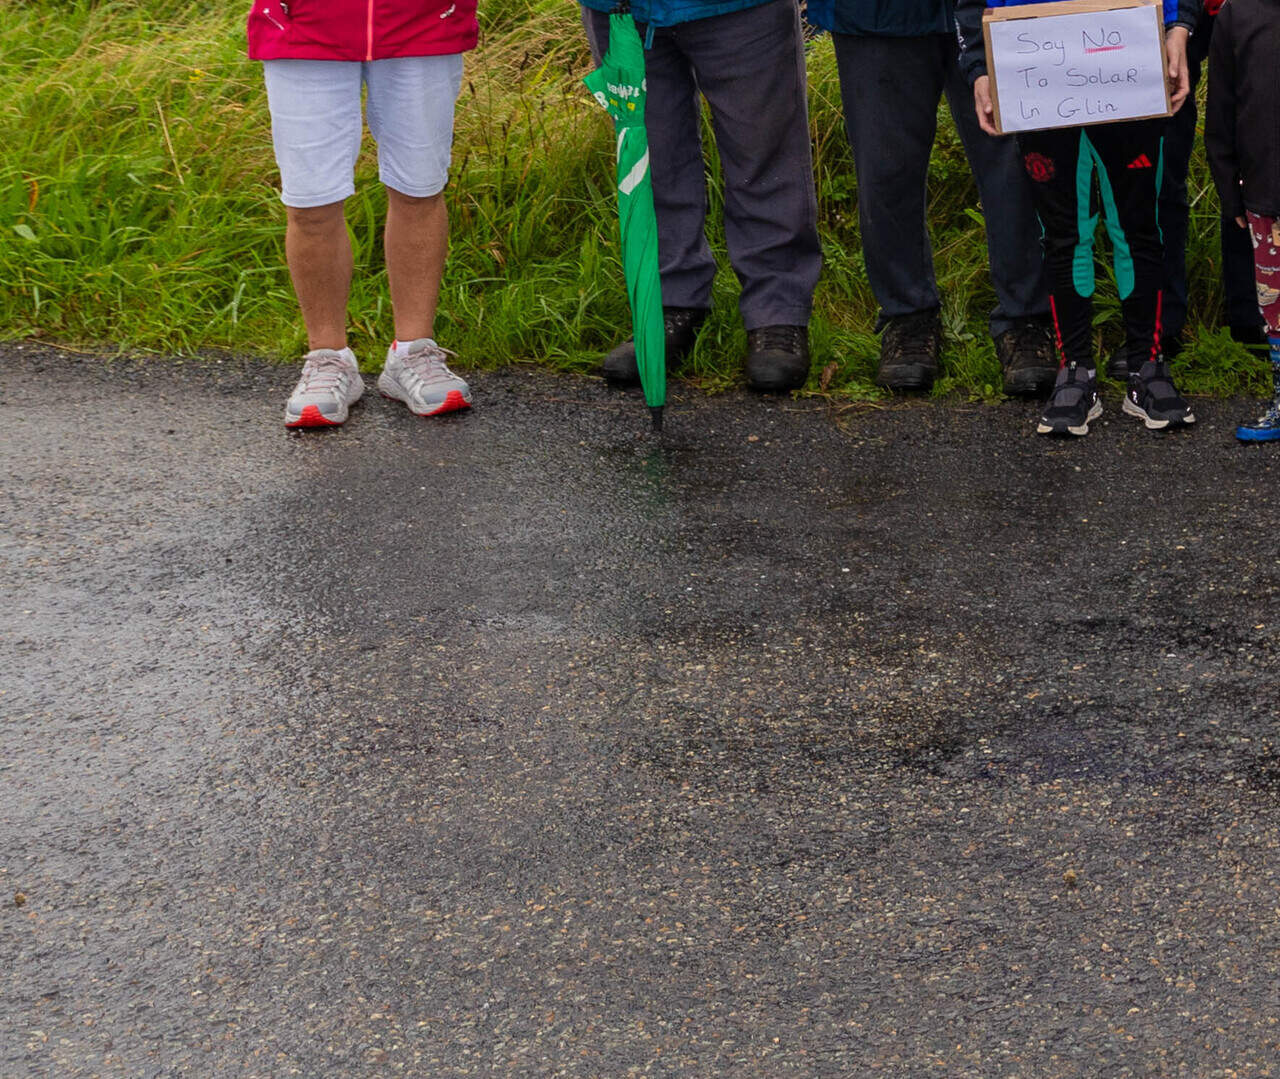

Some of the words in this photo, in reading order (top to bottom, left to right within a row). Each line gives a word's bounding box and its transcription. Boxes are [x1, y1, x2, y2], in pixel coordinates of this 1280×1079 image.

[1016, 32, 1065, 66] Say
[1082, 28, 1121, 47] NO
[1017, 67, 1048, 87] To
